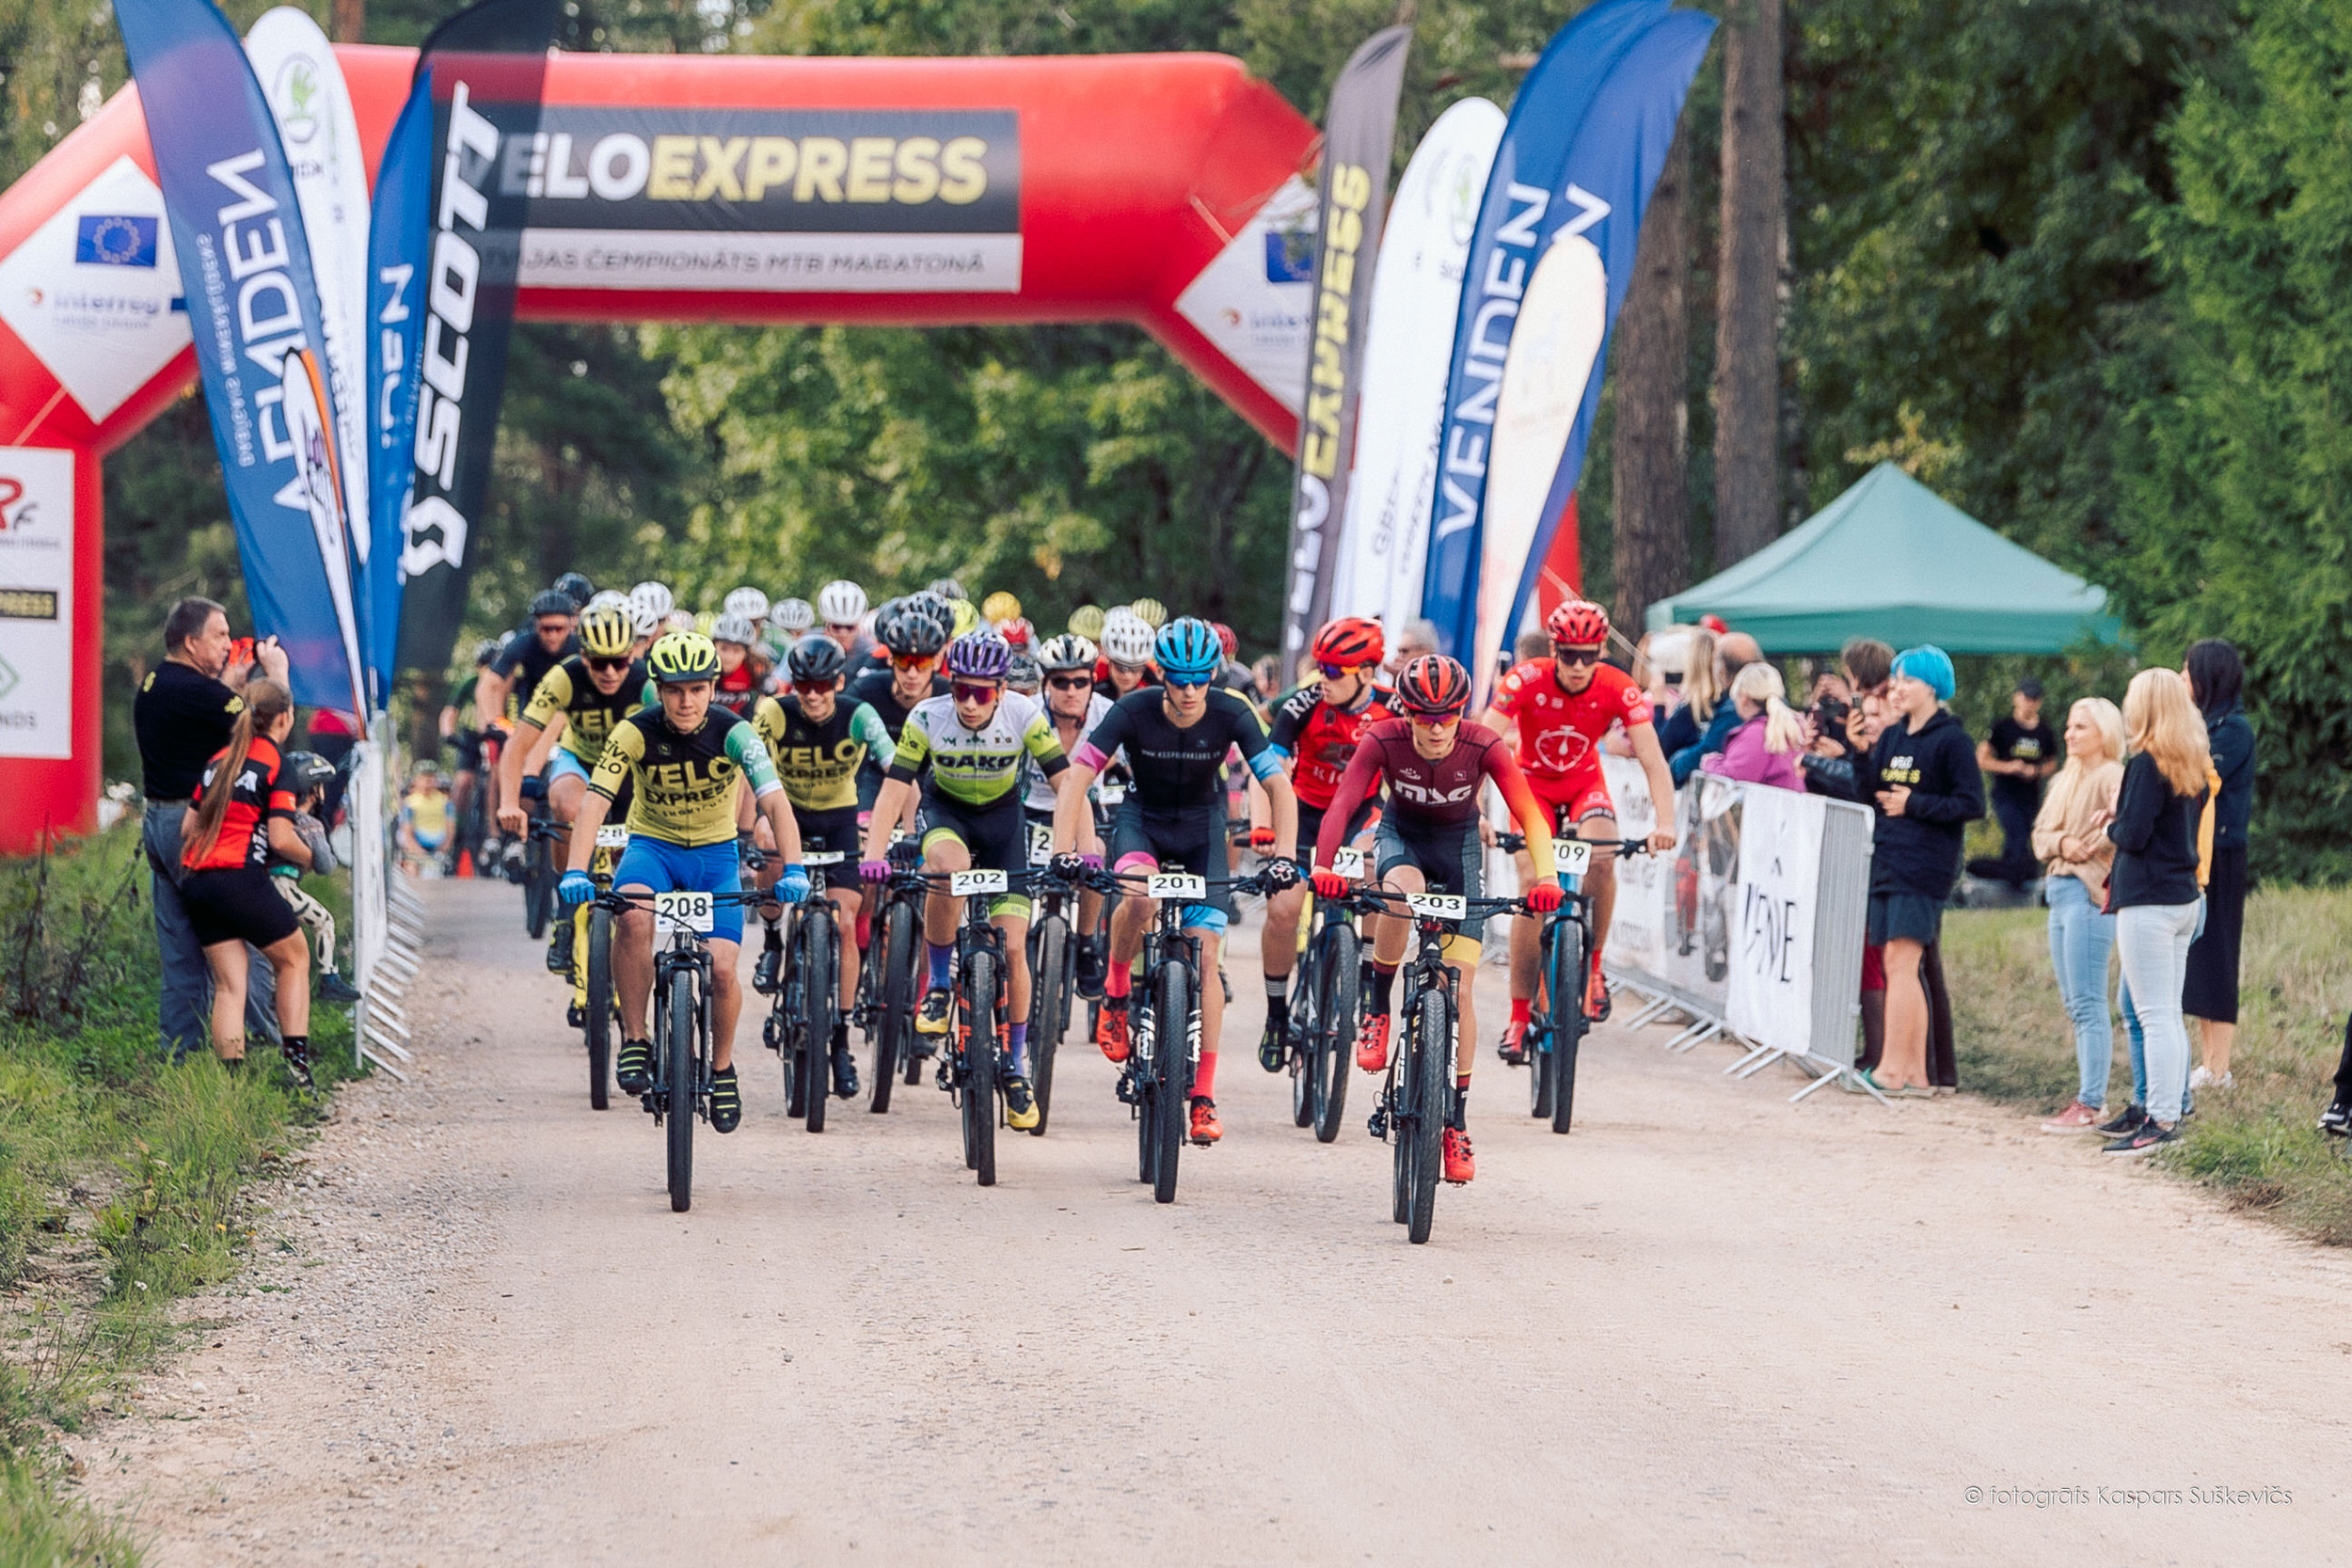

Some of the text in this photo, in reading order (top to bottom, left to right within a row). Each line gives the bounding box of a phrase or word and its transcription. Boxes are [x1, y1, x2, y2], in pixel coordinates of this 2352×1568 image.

[586, 243, 758, 272] ČEMPIONĀTS
[768, 251, 824, 272] MTB
[832, 248, 986, 274] MARATONĀ
[415, 80, 499, 490] SCOTT
[1437, 181, 1550, 540] VENDEN
[645, 756, 734, 789] VELO
[1334, 851, 1359, 866] 07
[1553, 844, 1585, 862] 09
[958, 872, 1002, 886] 202
[1154, 877, 1197, 890] 201
[661, 896, 707, 918] 208
[1412, 895, 1461, 911] 203
